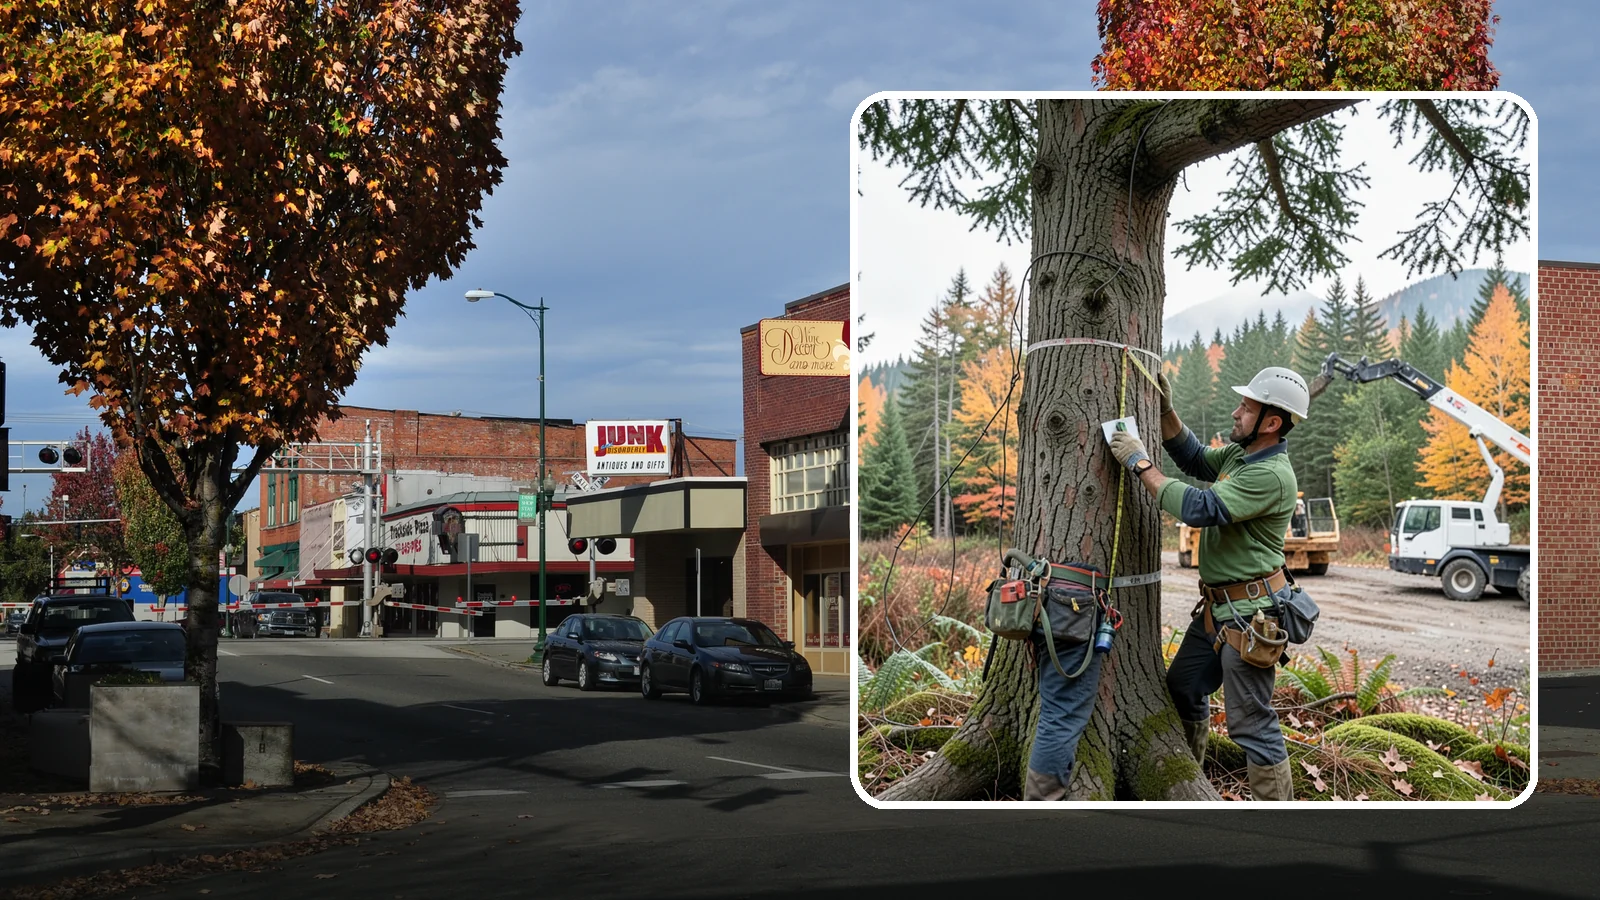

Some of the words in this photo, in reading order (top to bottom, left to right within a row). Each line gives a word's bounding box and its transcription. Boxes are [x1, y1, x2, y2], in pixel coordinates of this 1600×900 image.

[595, 425, 665, 457] JUNK
[607, 446, 646, 454] DISORDERLY
[597, 461, 628, 470] ANTIQUES
[631, 461, 644, 470] AND
[646, 460, 665, 470] GIFTS
[414, 519, 429, 534] Pizza
